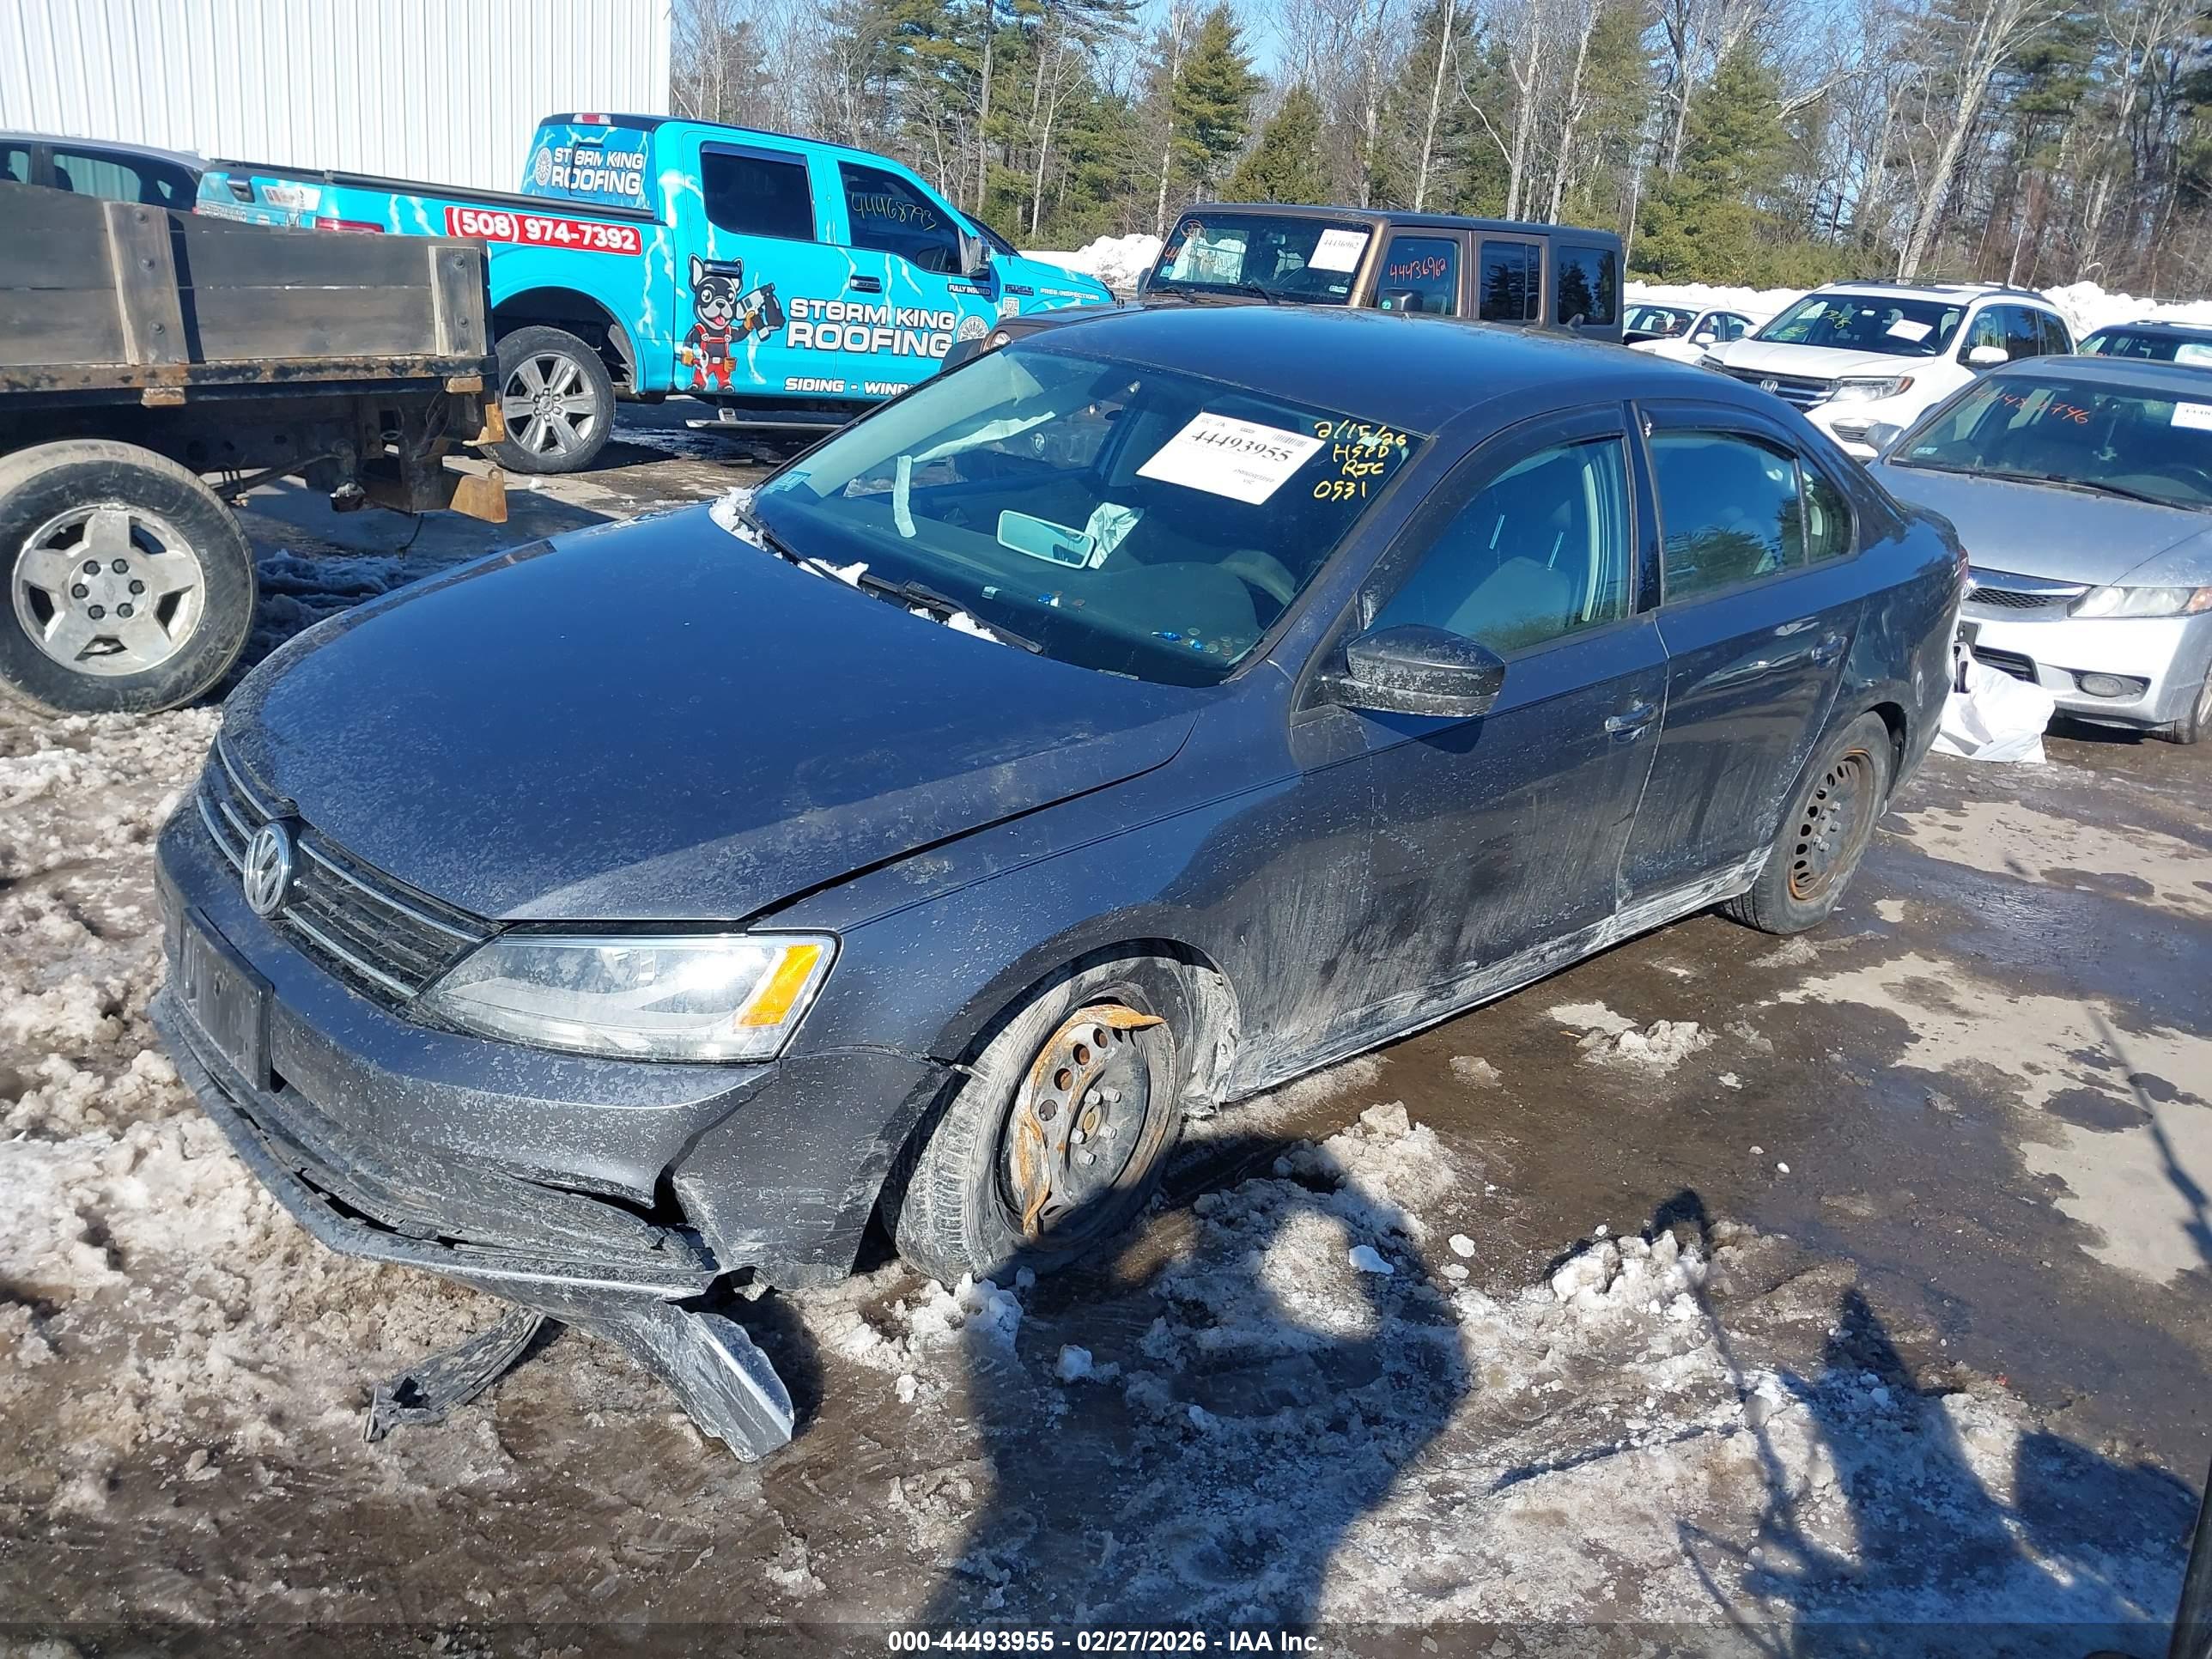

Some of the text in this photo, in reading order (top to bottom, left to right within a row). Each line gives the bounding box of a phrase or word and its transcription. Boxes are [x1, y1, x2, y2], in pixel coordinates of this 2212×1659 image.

[605, 150, 644, 170] KING
[550, 165, 641, 196] ROOFING
[851, 191, 937, 232] 44468793
[453, 207, 637, 251] (508) 974-7392
[1389, 257, 1447, 284] 44436962
[948, 284, 991, 296] FULLY INSURED
[1059, 289, 1100, 301] INSPECTIONS
[789, 297, 889, 326] STORM
[895, 306, 957, 331] KING
[786, 320, 955, 359] ROOFING
[784, 376, 846, 393] SIDING
[1191, 430, 1294, 463] 44493955
[1313, 480, 1366, 502] 0531
